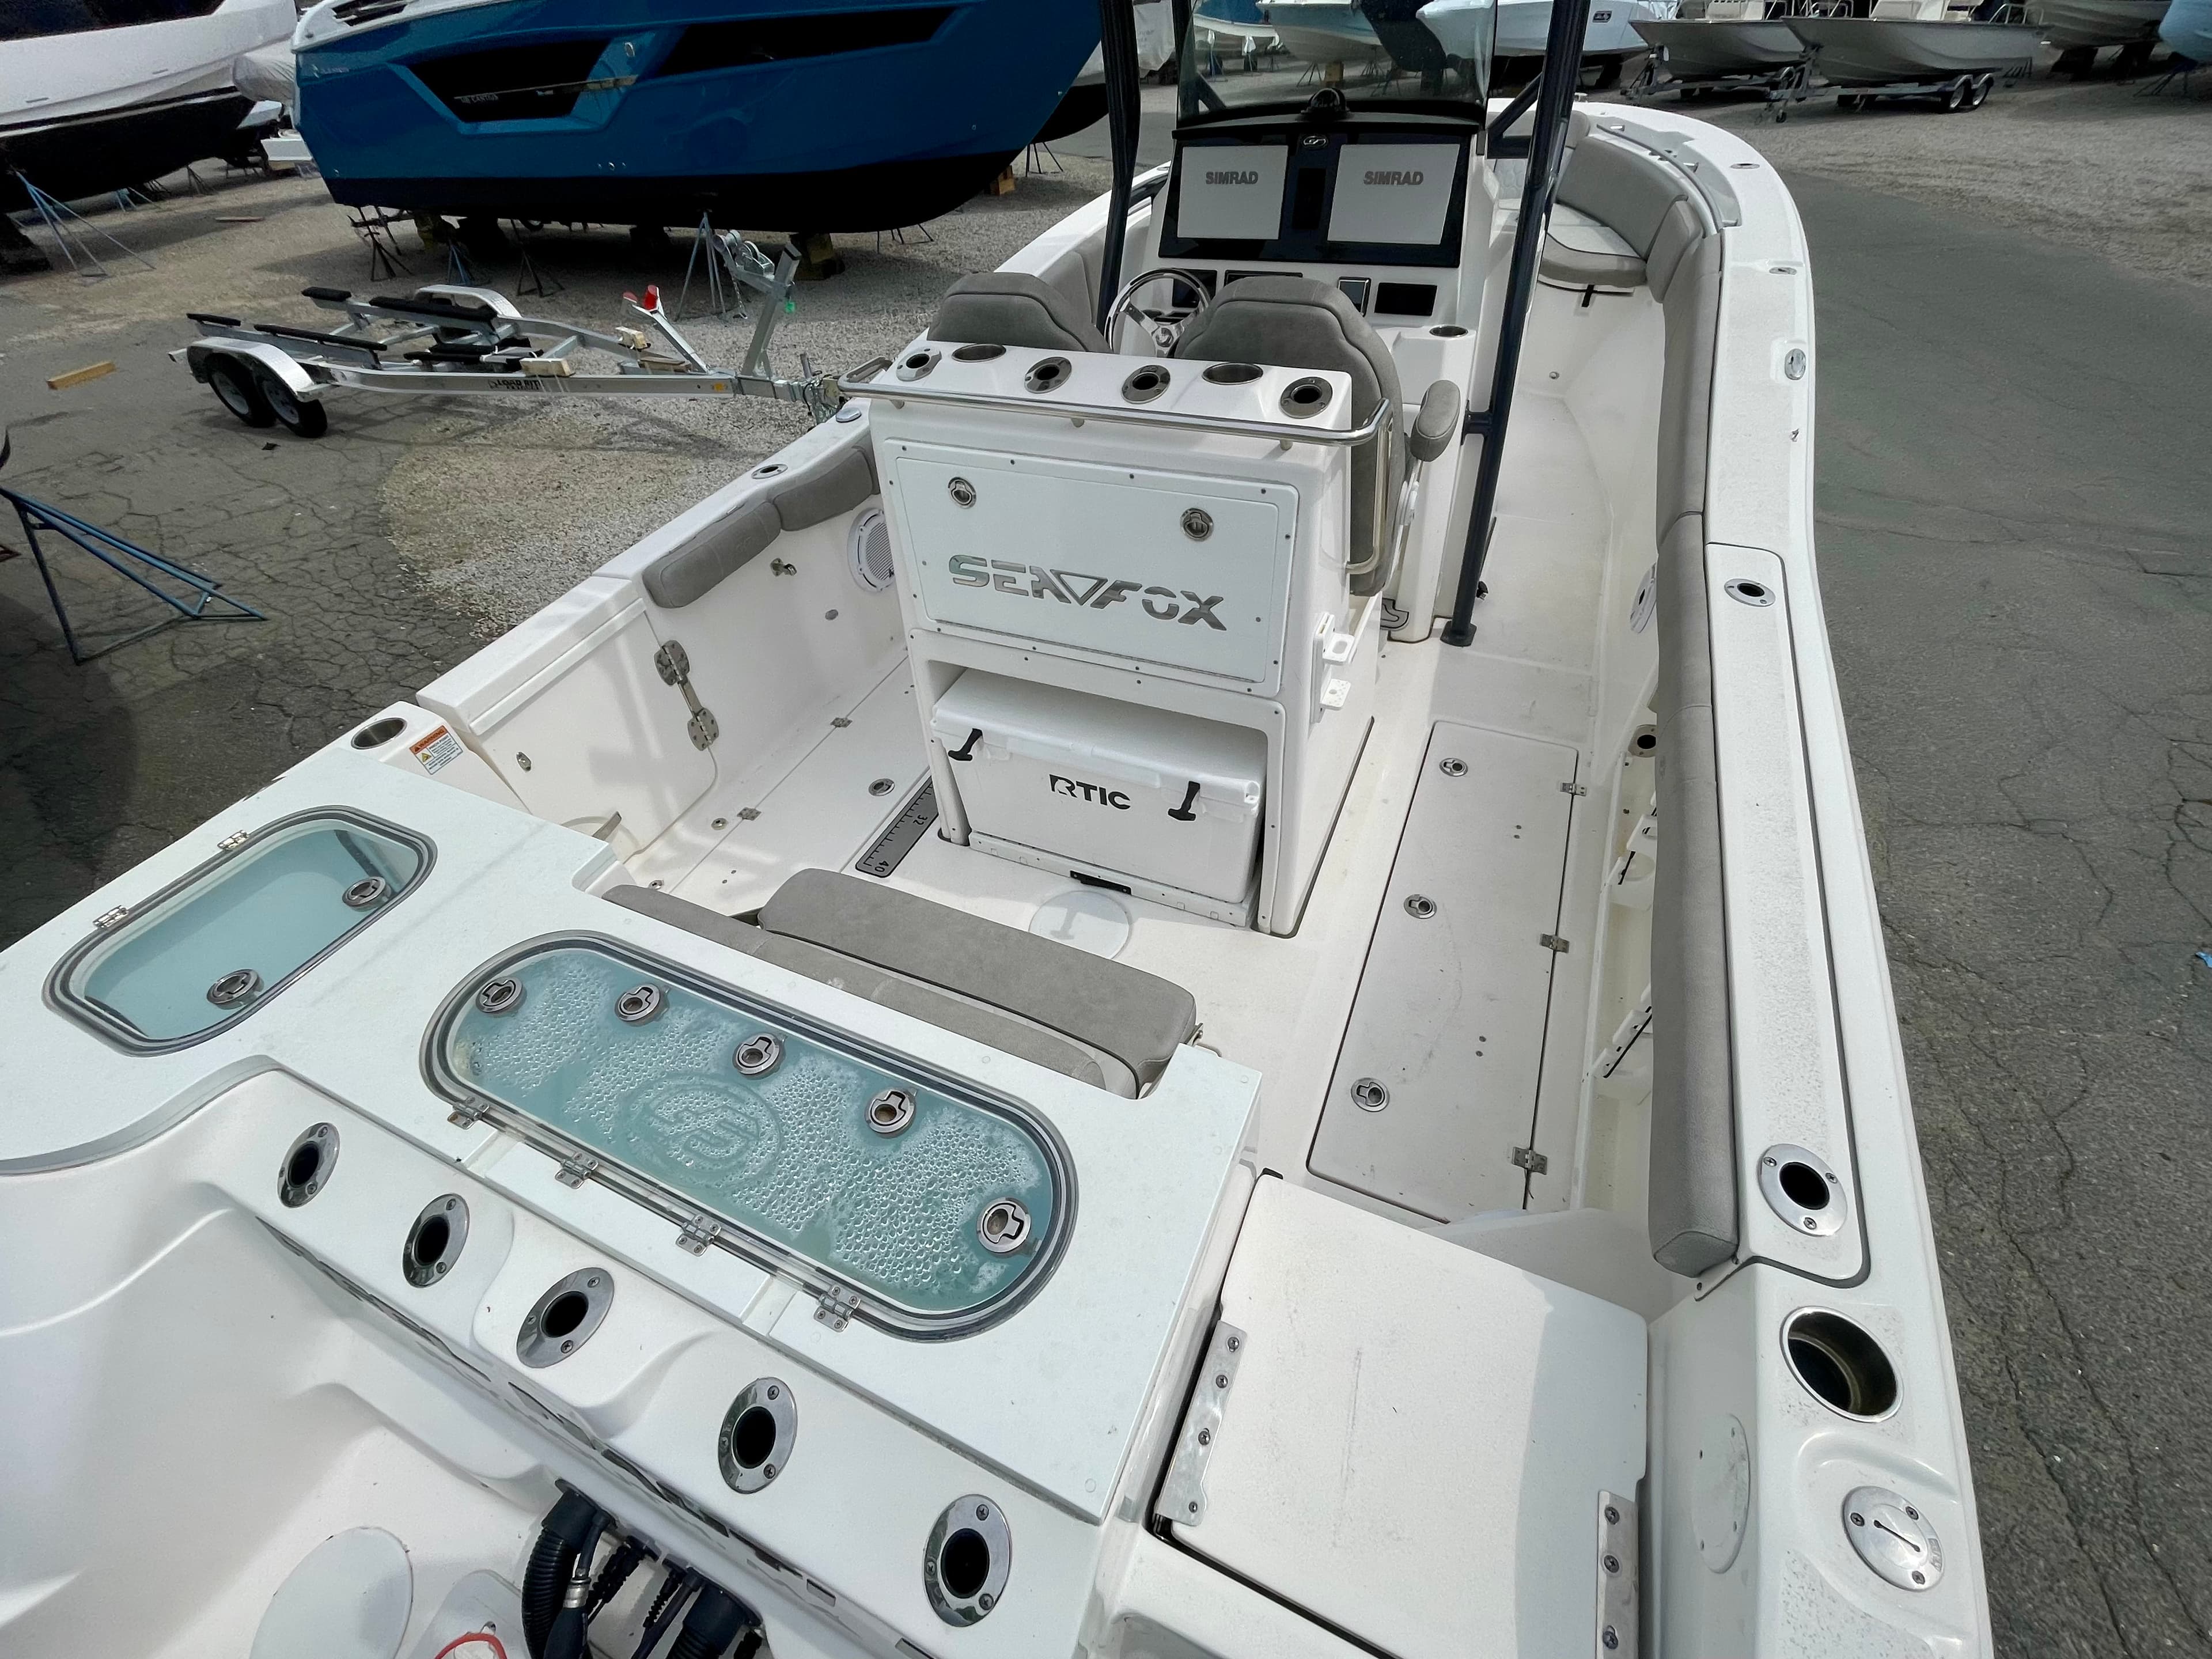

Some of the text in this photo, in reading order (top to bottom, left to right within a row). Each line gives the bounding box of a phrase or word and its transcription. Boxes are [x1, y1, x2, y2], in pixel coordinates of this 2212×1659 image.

[1206, 171, 1259, 185] SIMRAD
[1363, 171, 1424, 185] SIMRAD
[418, 729, 445, 748] WARNING
[1049, 774, 1131, 810] RTIC
[912, 815, 928, 825] 32
[874, 860, 889, 872] 40
